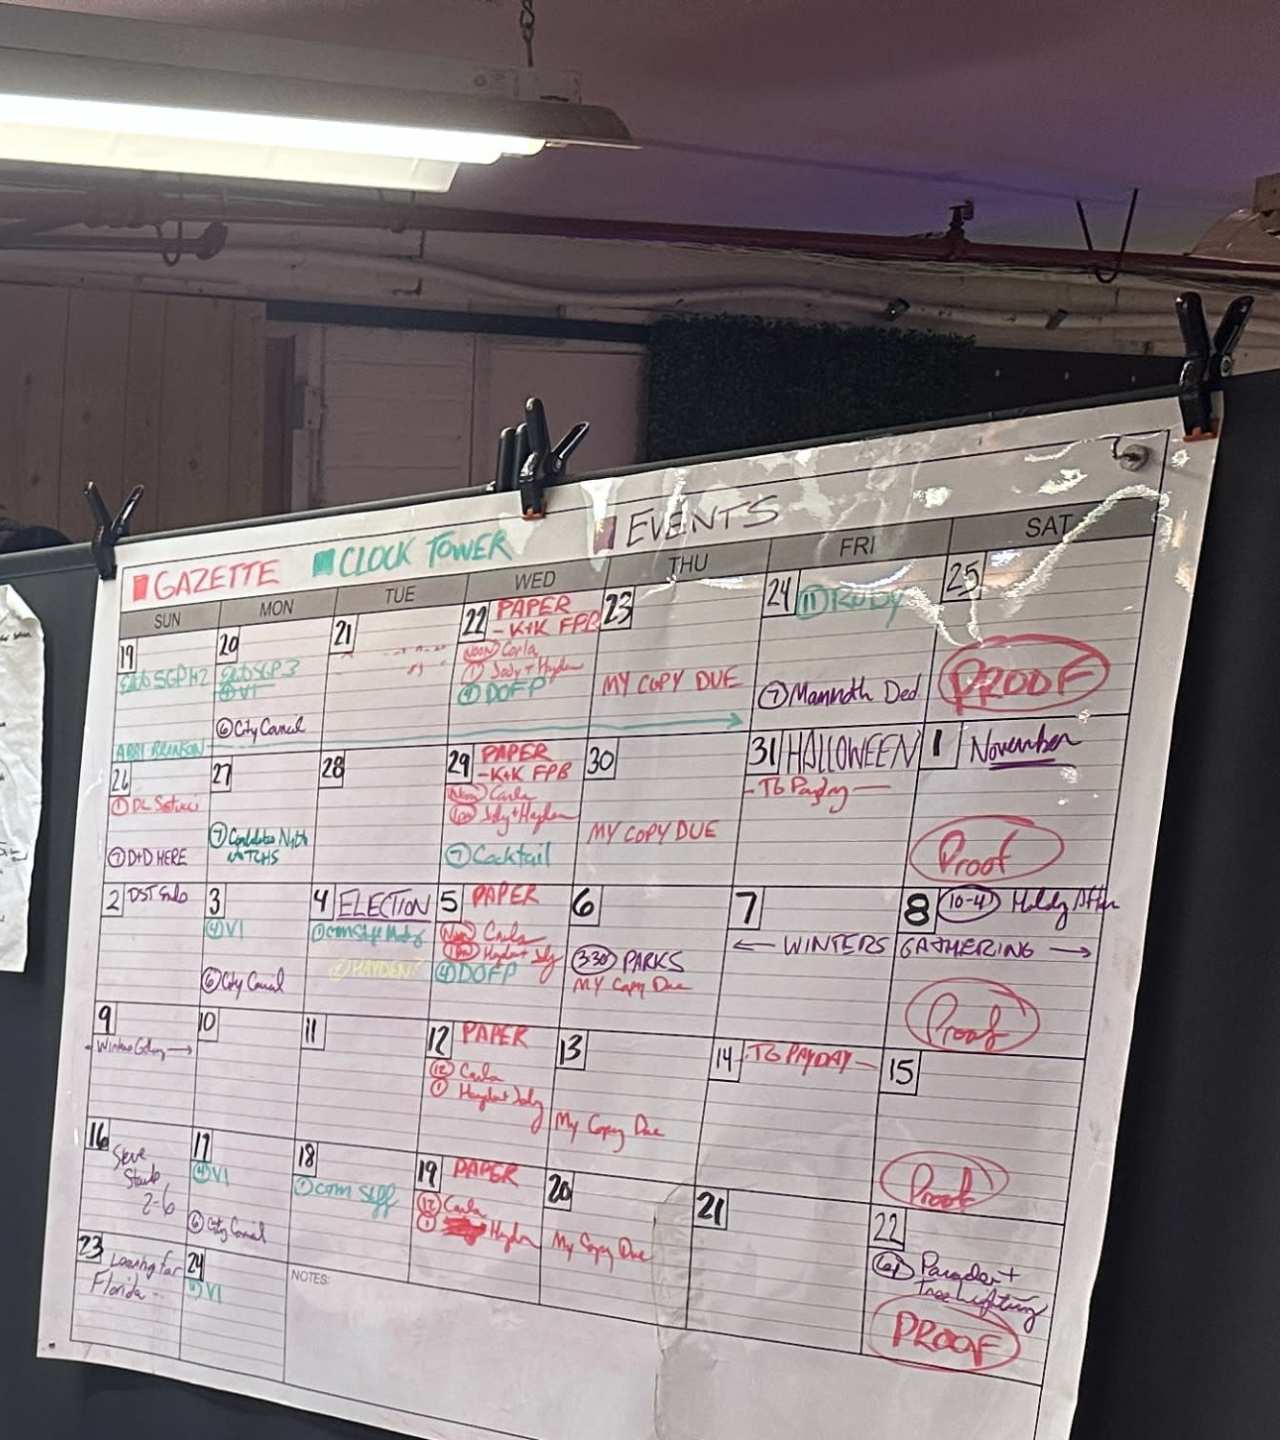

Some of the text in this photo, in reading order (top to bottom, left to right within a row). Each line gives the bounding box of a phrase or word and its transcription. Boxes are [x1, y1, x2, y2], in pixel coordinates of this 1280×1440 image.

[154, 496, 779, 601] GAZETTE CLOCK TOWER EVENTS
[154, 514, 1074, 629] SUN MON TUE WED THU FRI SAT
[946, 560, 979, 597] 25
[496, 595, 571, 620] PAPER
[604, 591, 632, 625] 23
[767, 577, 790, 612] 24
[334, 620, 351, 646] 21
[462, 606, 487, 636] 22
[120, 645, 134, 670] 19
[219, 633, 239, 656] 20
[603, 666, 741, 696] MY COPY DUE
[949, 652, 1095, 715] PROOF
[481, 743, 553, 764] PAPER
[749, 736, 776, 766] 31
[786, 729, 922, 774] HALLOWEEN
[933, 728, 942, 757] 1
[970, 723, 1083, 763] November
[213, 762, 232, 786] 27
[322, 756, 345, 779] 28
[448, 749, 470, 777] 29
[587, 746, 615, 774] 30
[112, 768, 129, 791] 26
[586, 819, 720, 846] MY COPY DUE
[156, 847, 188, 867] HERE
[106, 889, 119, 911] 2
[209, 887, 221, 915] 3
[313, 888, 329, 912] 4
[338, 887, 432, 918] ELECTION
[440, 890, 458, 912] 5
[472, 881, 540, 908] PAPER
[571, 887, 595, 917] 6
[735, 891, 758, 925] 7
[904, 892, 929, 926] 8
[783, 932, 1035, 959] WINTERS GATHERING
[622, 949, 685, 974] PARKS
[98, 1005, 112, 1035] 9
[198, 1011, 216, 1033] 10
[305, 1017, 317, 1043] 11
[461, 1020, 529, 1049] PAPER
[428, 1025, 450, 1056] 12
[559, 1033, 583, 1066] 13
[716, 1045, 733, 1072] 14
[785, 1042, 853, 1077] PAYDAY
[889, 1057, 914, 1085] 15
[89, 1122, 110, 1151] 16
[555, 1111, 580, 1144] My
[634, 1113, 665, 1138] Due
[194, 1131, 210, 1162] 17
[298, 1143, 315, 1168] 18
[418, 1159, 438, 1188] 19
[453, 1158, 519, 1188] PAPER
[547, 1173, 573, 1203] 20
[696, 1191, 723, 1227] 21
[872, 1212, 898, 1246] 22
[78, 1235, 104, 1260] 23
[187, 1251, 204, 1282] 24
[291, 1269, 329, 1286] NOTES
[892, 1310, 1003, 1367] PROOF
